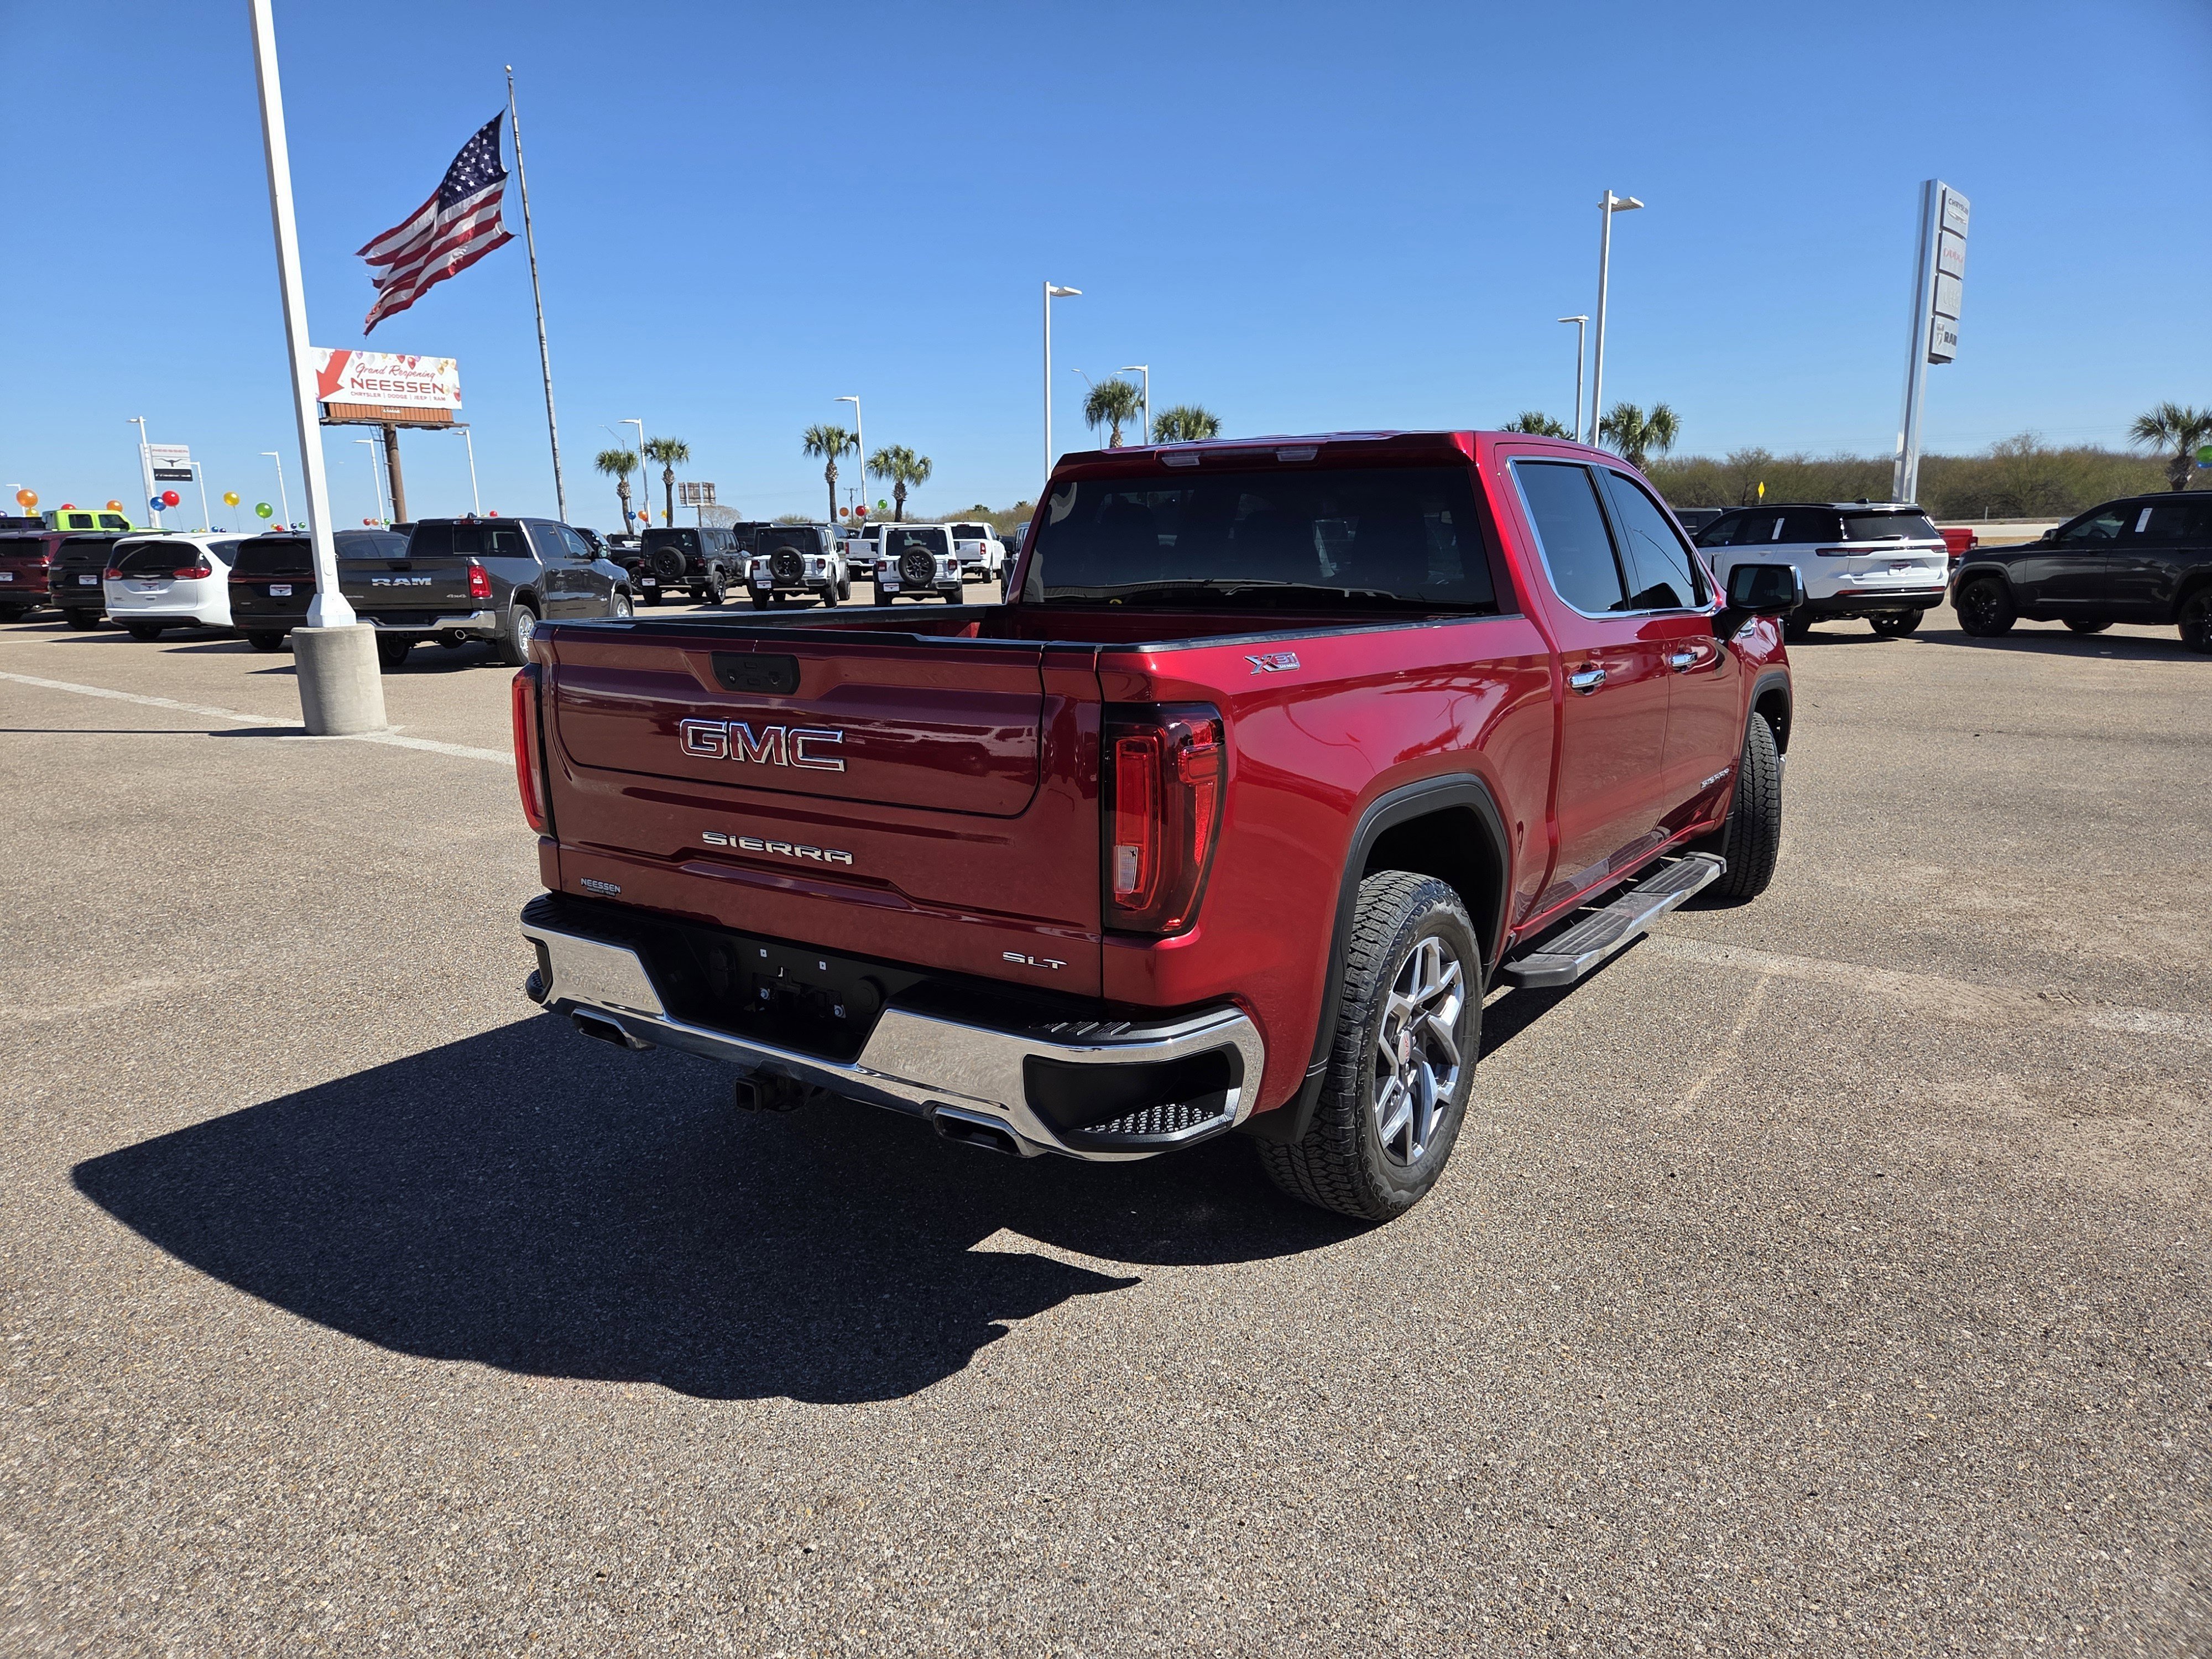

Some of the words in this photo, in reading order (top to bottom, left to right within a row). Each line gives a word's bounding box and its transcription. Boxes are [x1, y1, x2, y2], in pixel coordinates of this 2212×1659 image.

[355, 363, 388, 378] Grand
[389, 365, 436, 382] Reopening
[351, 377, 445, 394] NEESSEN
[372, 577, 431, 586] RAM
[680, 718, 845, 773] GMC
[702, 831, 853, 865] SIERRA
[581, 878, 621, 894] NEESSEN
[1002, 951, 1068, 970] SLT
